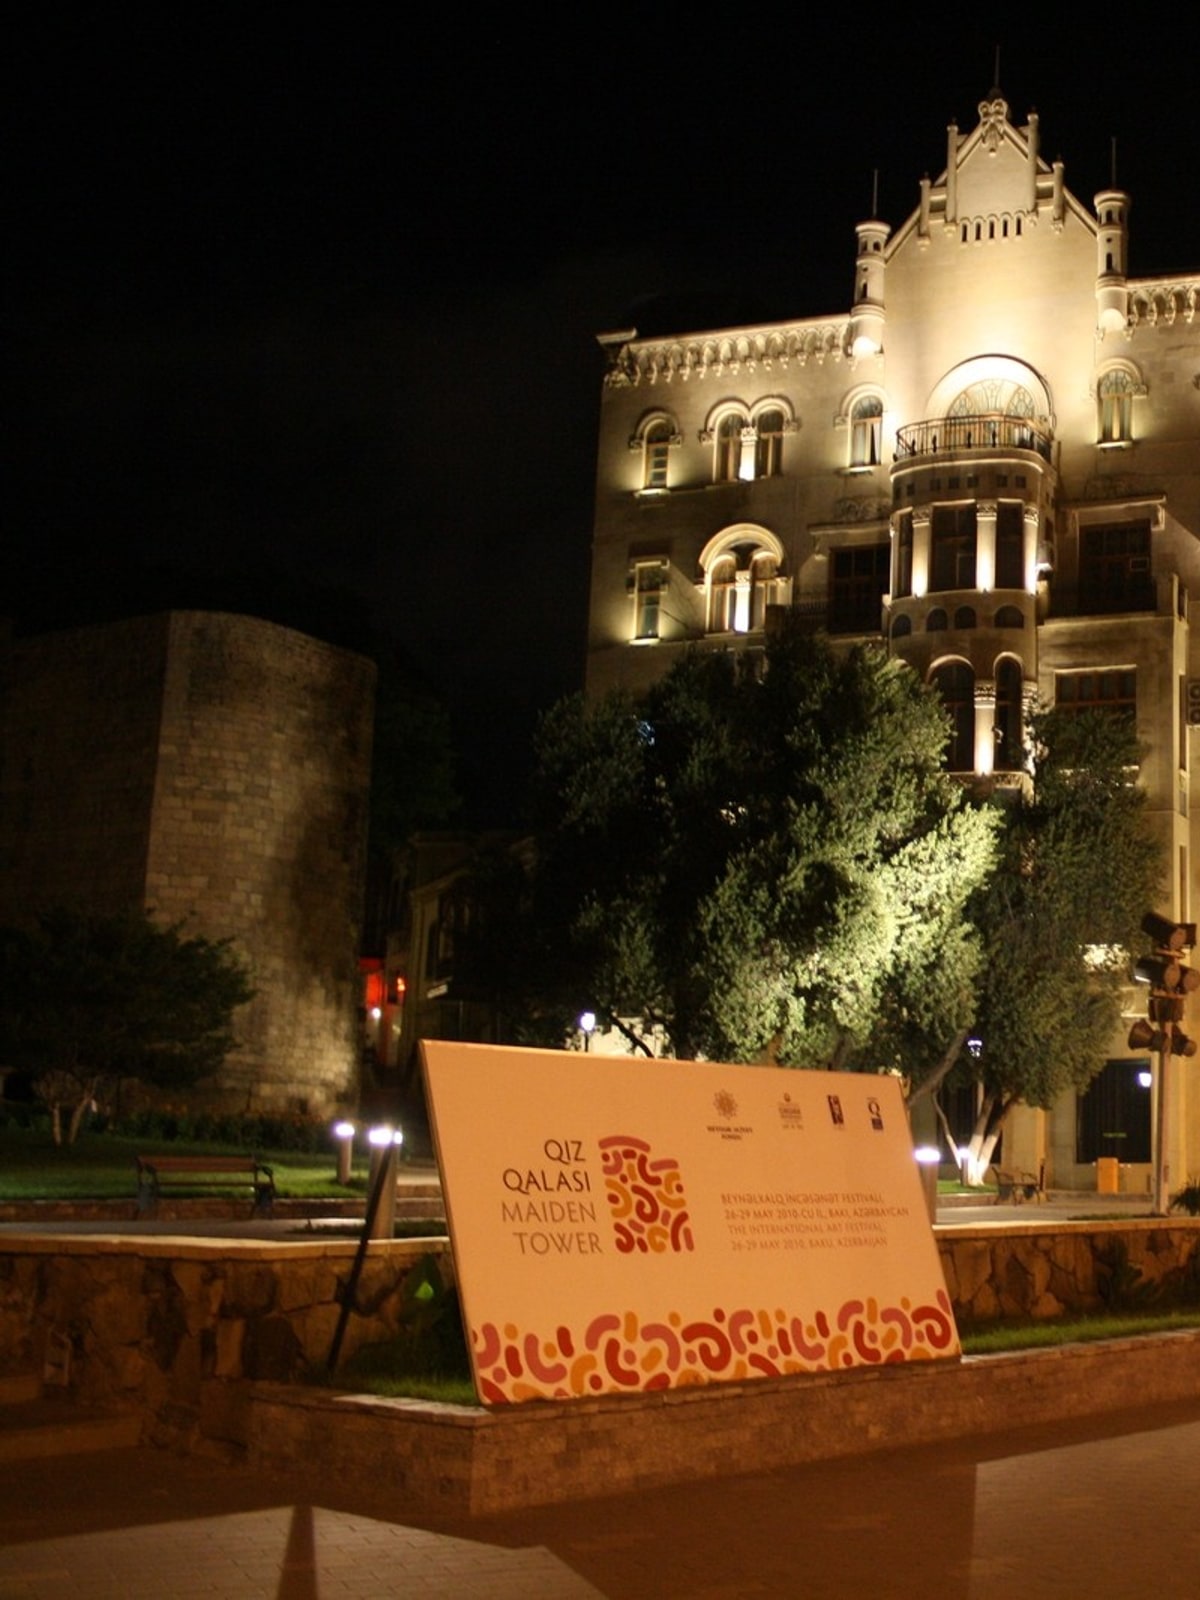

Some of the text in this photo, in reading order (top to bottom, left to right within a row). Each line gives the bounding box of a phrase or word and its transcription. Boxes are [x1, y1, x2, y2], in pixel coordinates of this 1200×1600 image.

[544, 1139, 586, 1165] QIZ
[503, 1168, 590, 1195] QALASI
[502, 1201, 597, 1223] MAIDEN
[513, 1231, 603, 1255] TOWER
